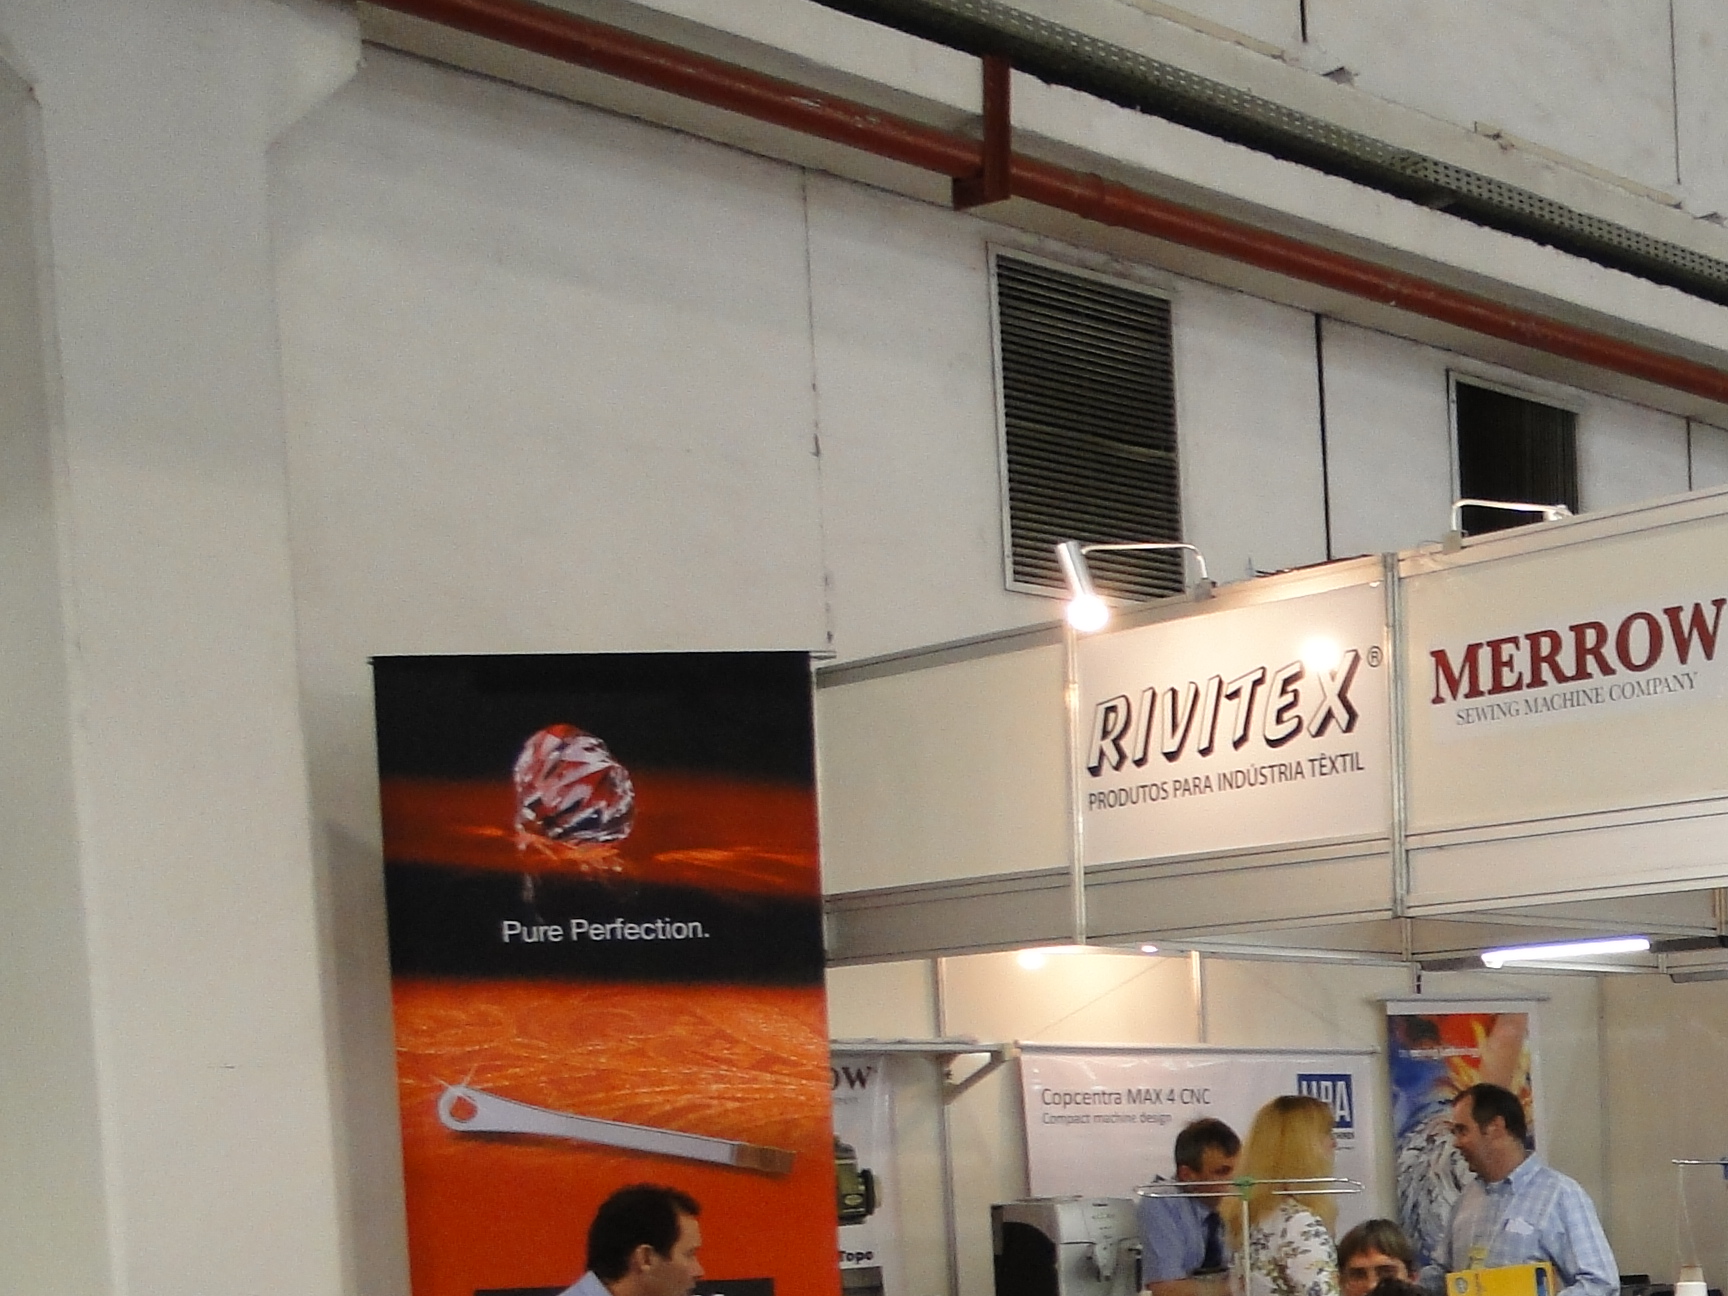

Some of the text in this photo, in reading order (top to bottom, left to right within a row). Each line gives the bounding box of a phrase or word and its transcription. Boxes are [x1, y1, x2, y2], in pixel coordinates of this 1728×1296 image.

[1456, 672, 1697, 726] SEWING MACHINE COMPANY
[1089, 752, 1365, 811] PRODUTOS PARA INDÚSTRIA TÊXTIL
[502, 918, 710, 943] Pure Perfection.
[1041, 1087, 1211, 1109] Copcentra MAX 4 CNC
[1042, 1111, 1172, 1126] Compact machine design
